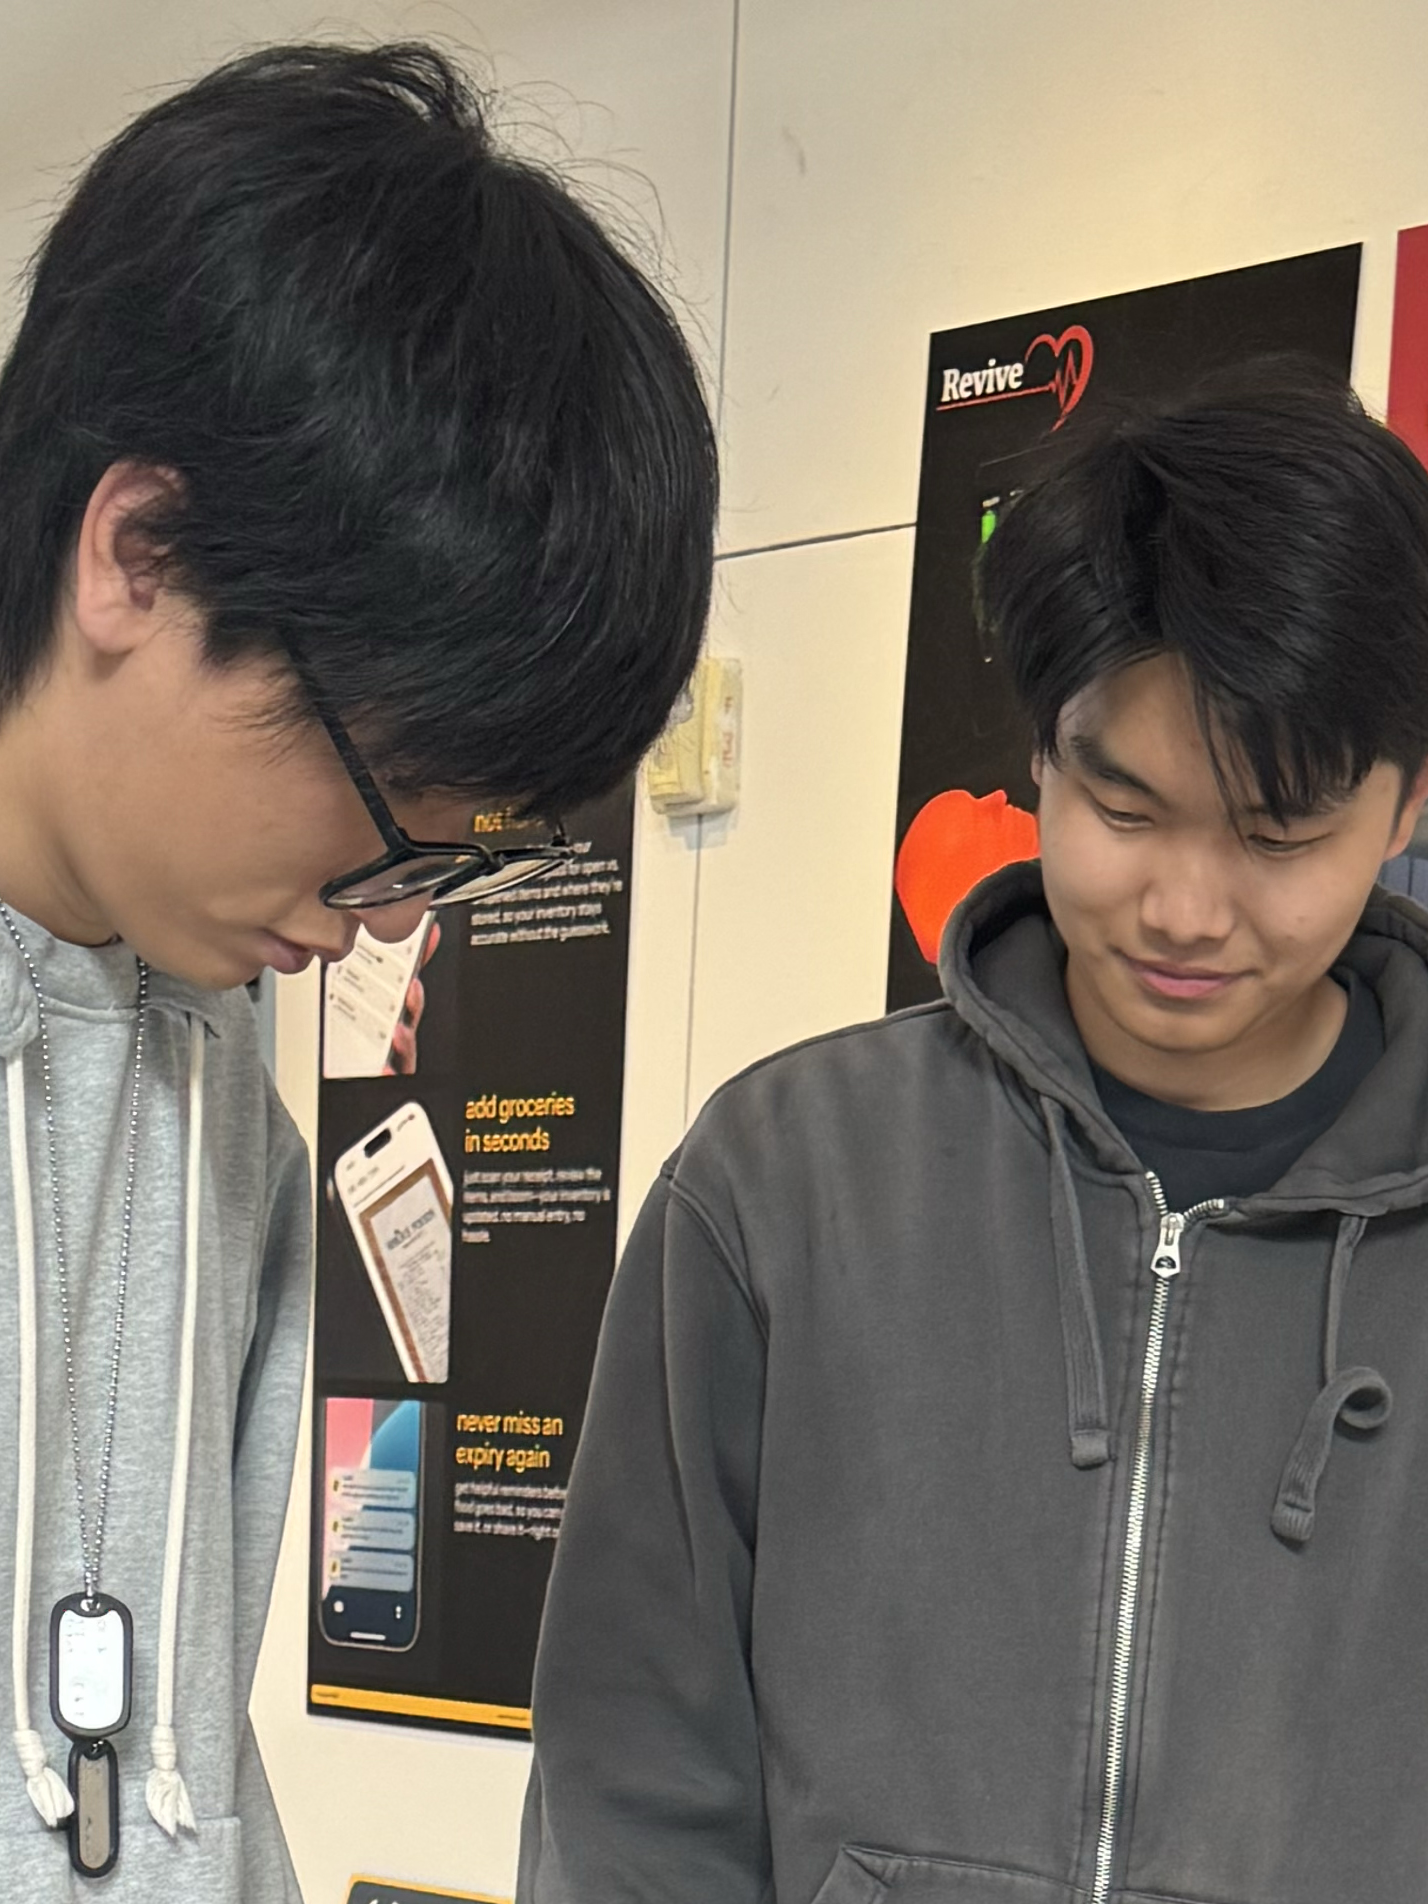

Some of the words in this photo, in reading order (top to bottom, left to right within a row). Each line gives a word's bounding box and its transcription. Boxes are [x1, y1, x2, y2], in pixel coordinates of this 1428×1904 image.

[941, 358, 1024, 402] Revive
[465, 1093, 497, 1120] add
[498, 1090, 575, 1124] groceries
[465, 1128, 481, 1153] in
[482, 1125, 550, 1153] seconds
[456, 1413, 502, 1434] never
[502, 1409, 541, 1436] miss
[542, 1416, 564, 1436] an
[455, 1441, 505, 1472] expiry
[505, 1443, 551, 1474] again
